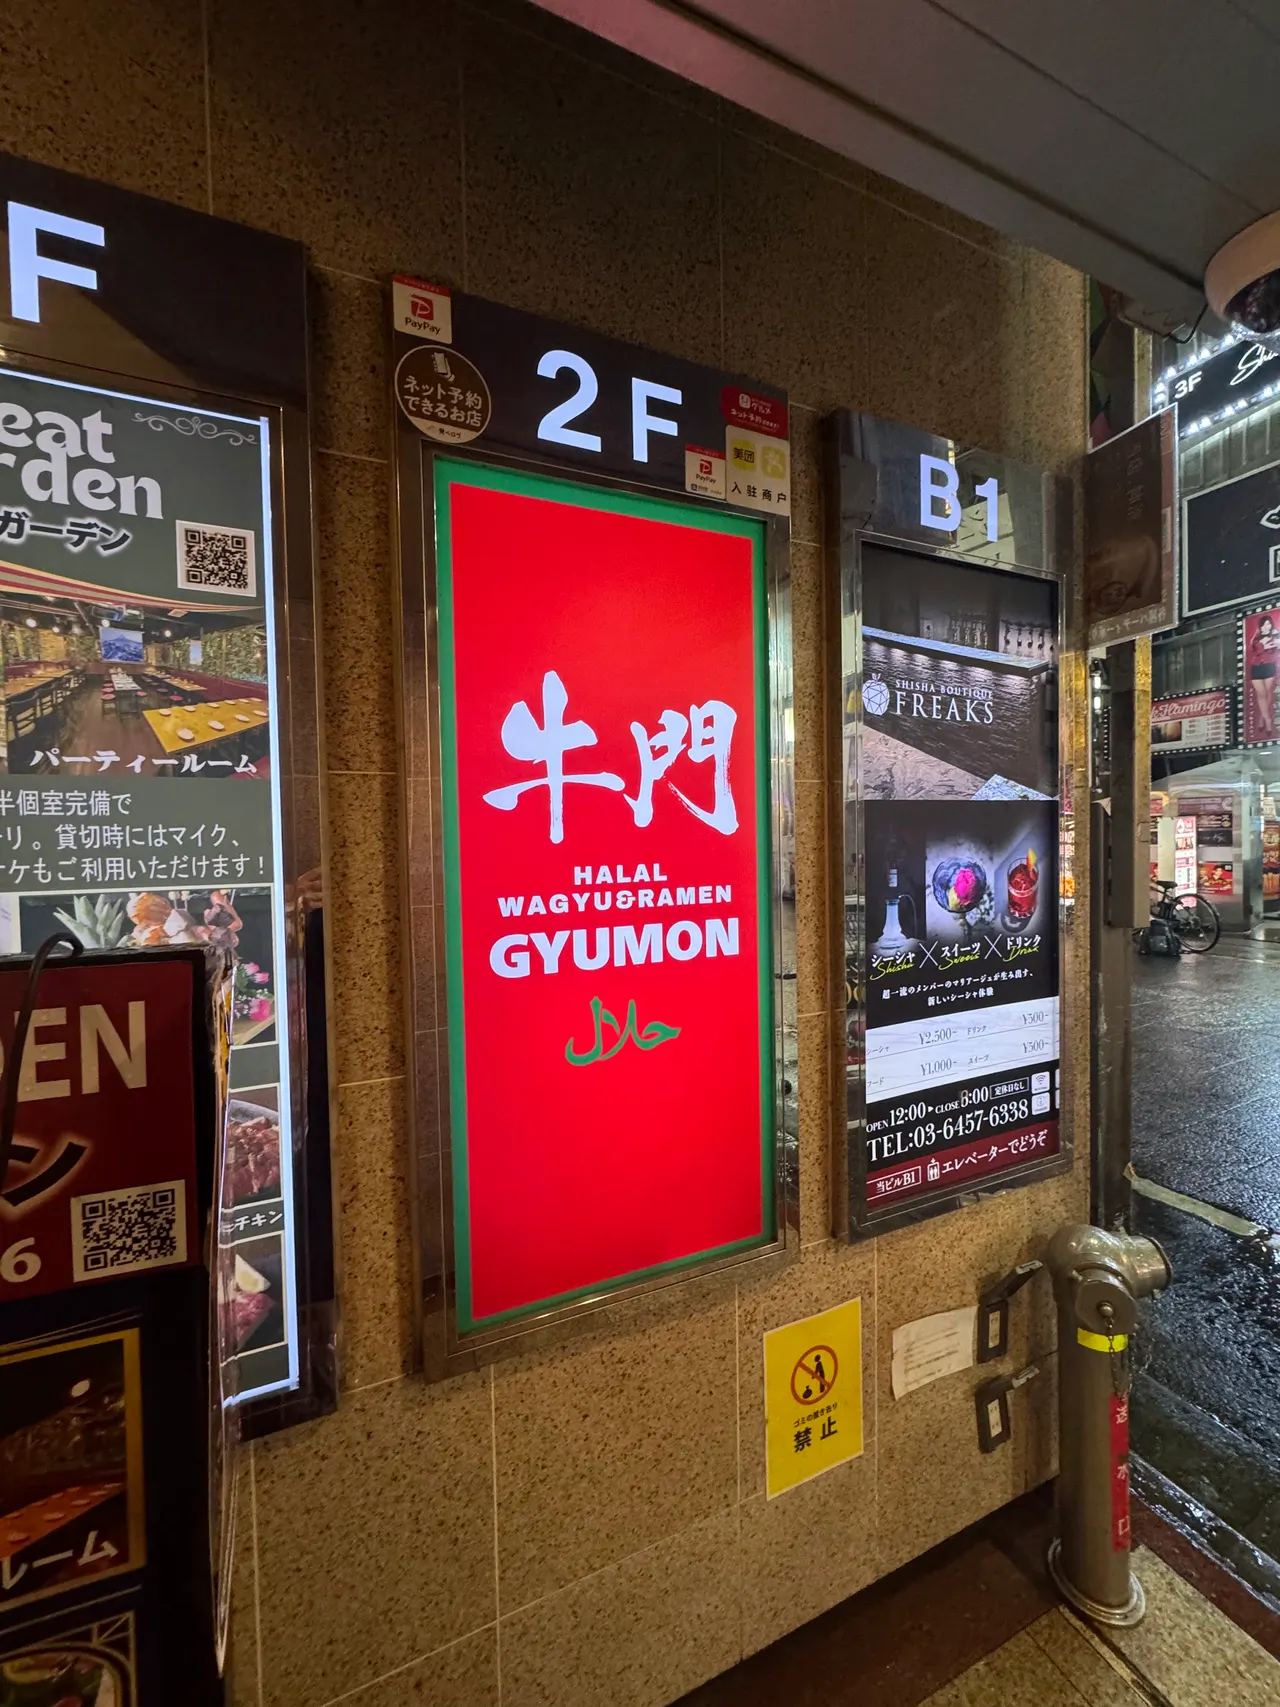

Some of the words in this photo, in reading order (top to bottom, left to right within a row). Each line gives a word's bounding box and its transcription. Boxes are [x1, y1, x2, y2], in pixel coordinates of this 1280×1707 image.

[8, 201, 105, 323] F
[405, 316, 441, 335] PayPay
[404, 375, 482, 409] ネット予約
[1174, 370, 1202, 399] 3F
[404, 395, 482, 427] できるお店
[733, 447, 755, 463] 美团
[695, 473, 717, 485] PayPay
[731, 481, 787, 503] 入驻商户
[920, 453, 998, 542] B1
[0, 509, 131, 552] ガーデン
[895, 680, 936, 693] SHISHA
[940, 685, 994, 700] BOUTIQUE
[895, 690, 994, 724] FREAKS
[29, 748, 257, 774] パーティールーム
[482, 669, 740, 844] 牛門
[574, 863, 667, 885] HALAL
[497, 884, 732, 917] WAGYU&RAMEN
[489, 917, 739, 978] GYUMON
[871, 952, 916, 968] シーシャ
[941, 942, 981, 958] スイーツ
[1007, 934, 1041, 950] ドリンク
[869, 957, 915, 980] Shisha
[565, 996, 681, 1066] حلال
[866, 1119, 889, 1133] OPEN
[889, 1101, 926, 1127] 12:00
[934, 1100, 960, 1114] CLOSE
[866, 1098, 1029, 1162] TEL:03-6457-6338
[941, 1128, 1048, 1174] エレベーターでどうぞ
[0, 1237, 42, 1283] 6
[793, 1416, 838, 1453] 禁止
